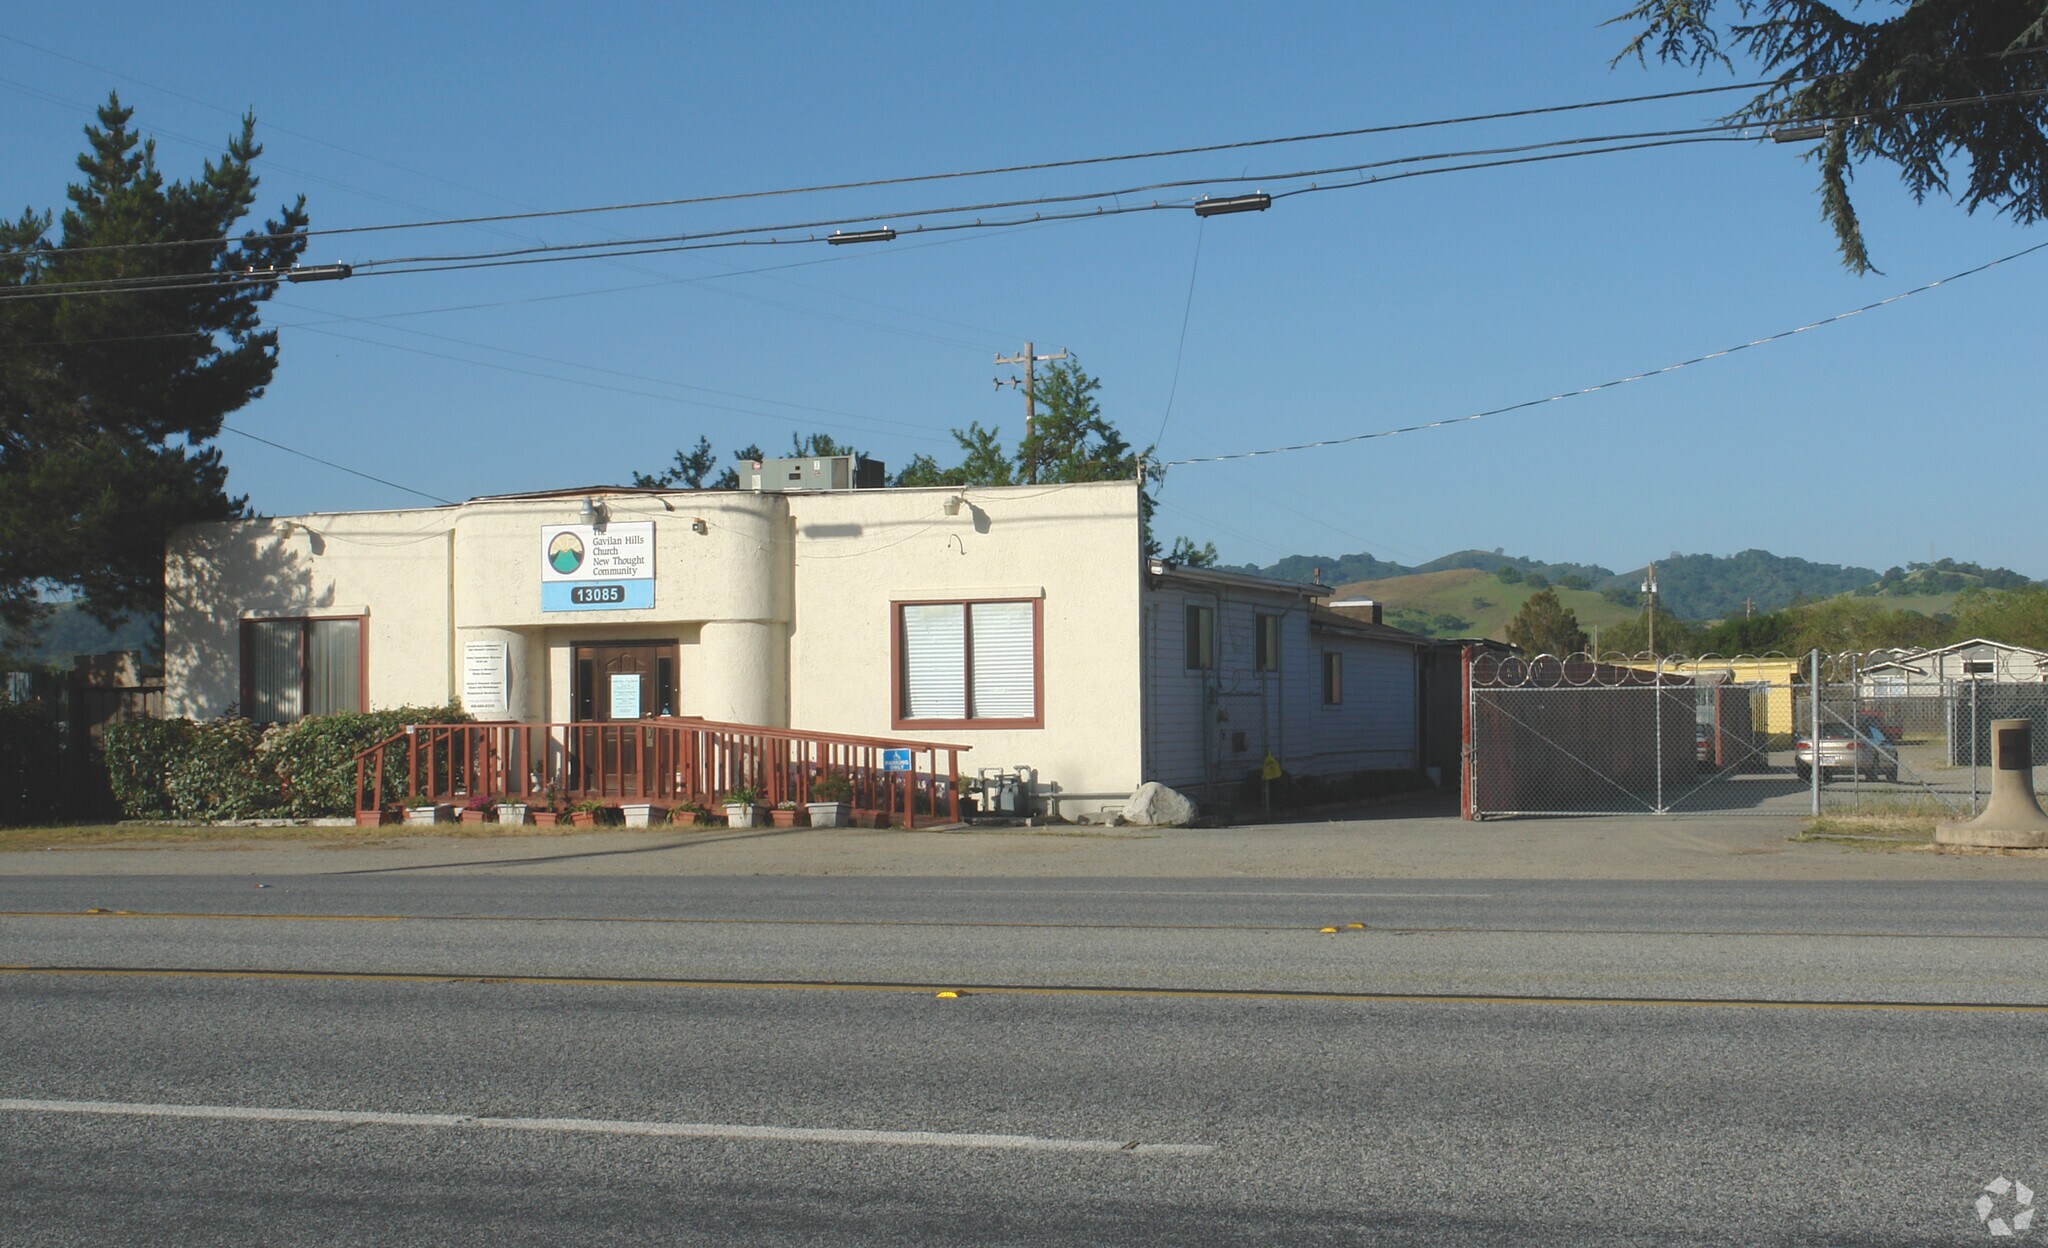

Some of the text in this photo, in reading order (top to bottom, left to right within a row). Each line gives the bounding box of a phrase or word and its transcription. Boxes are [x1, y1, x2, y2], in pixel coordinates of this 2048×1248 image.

[592, 535, 644, 546] Gavilan Hills
[592, 546, 619, 556] Church
[593, 555, 645, 567] New Thought
[592, 566, 638, 577] Community
[577, 588, 619, 602] 13085
